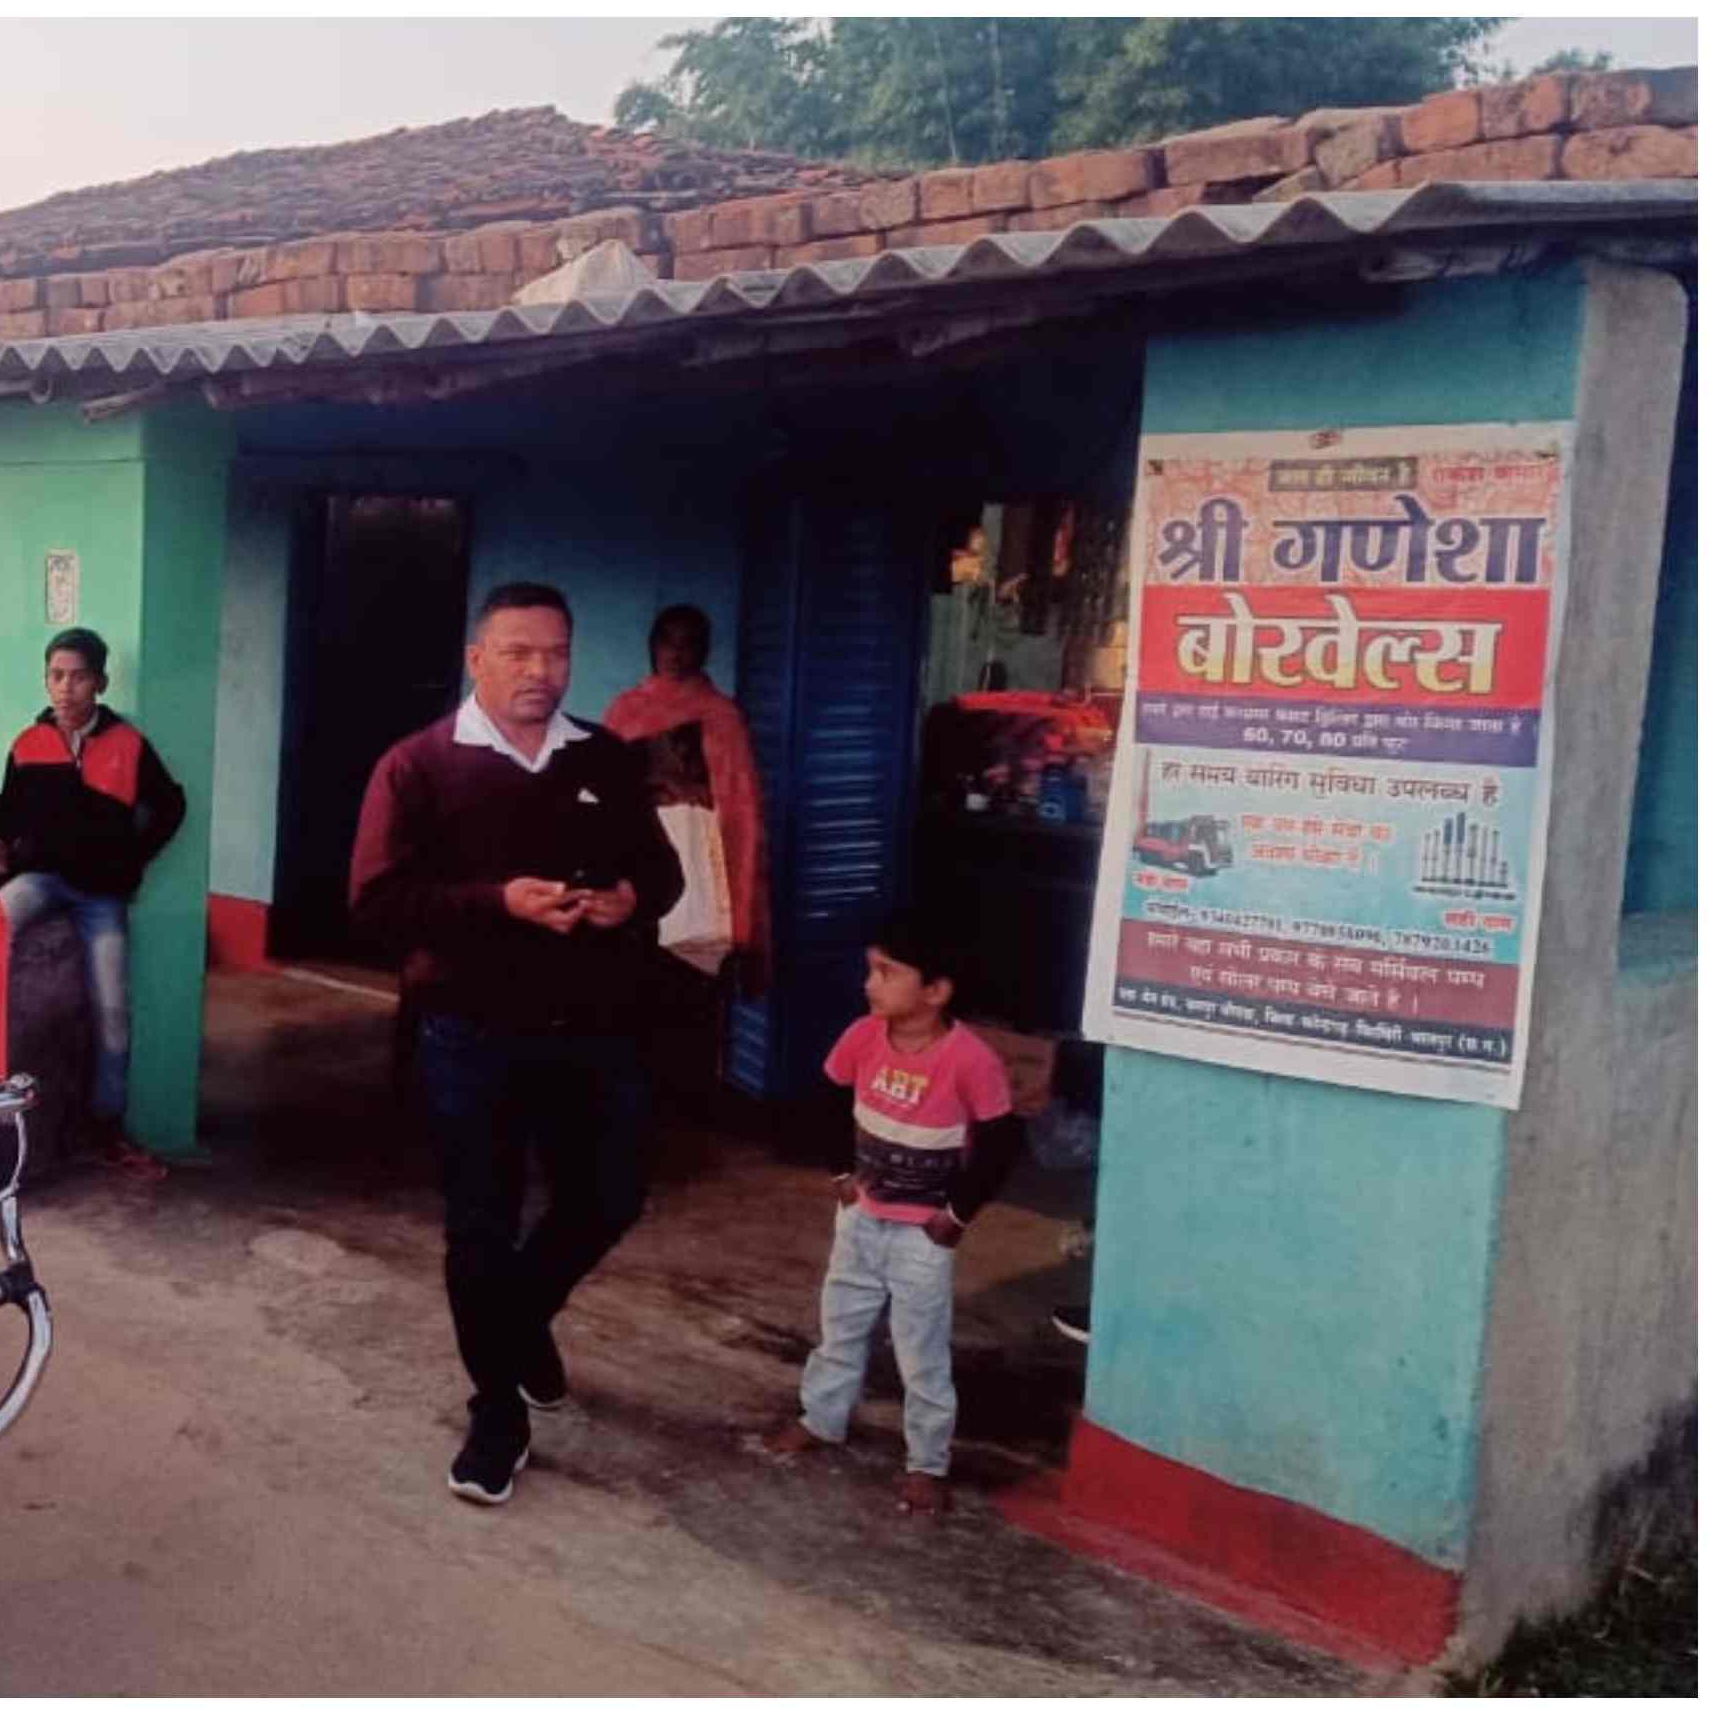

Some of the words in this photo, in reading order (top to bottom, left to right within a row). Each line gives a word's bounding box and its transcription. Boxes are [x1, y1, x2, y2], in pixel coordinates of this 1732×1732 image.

[1157, 496, 1248, 583] श्री
[1272, 494, 1547, 584] गणेशा
[1175, 592, 1503, 695] बोरवेल्स
